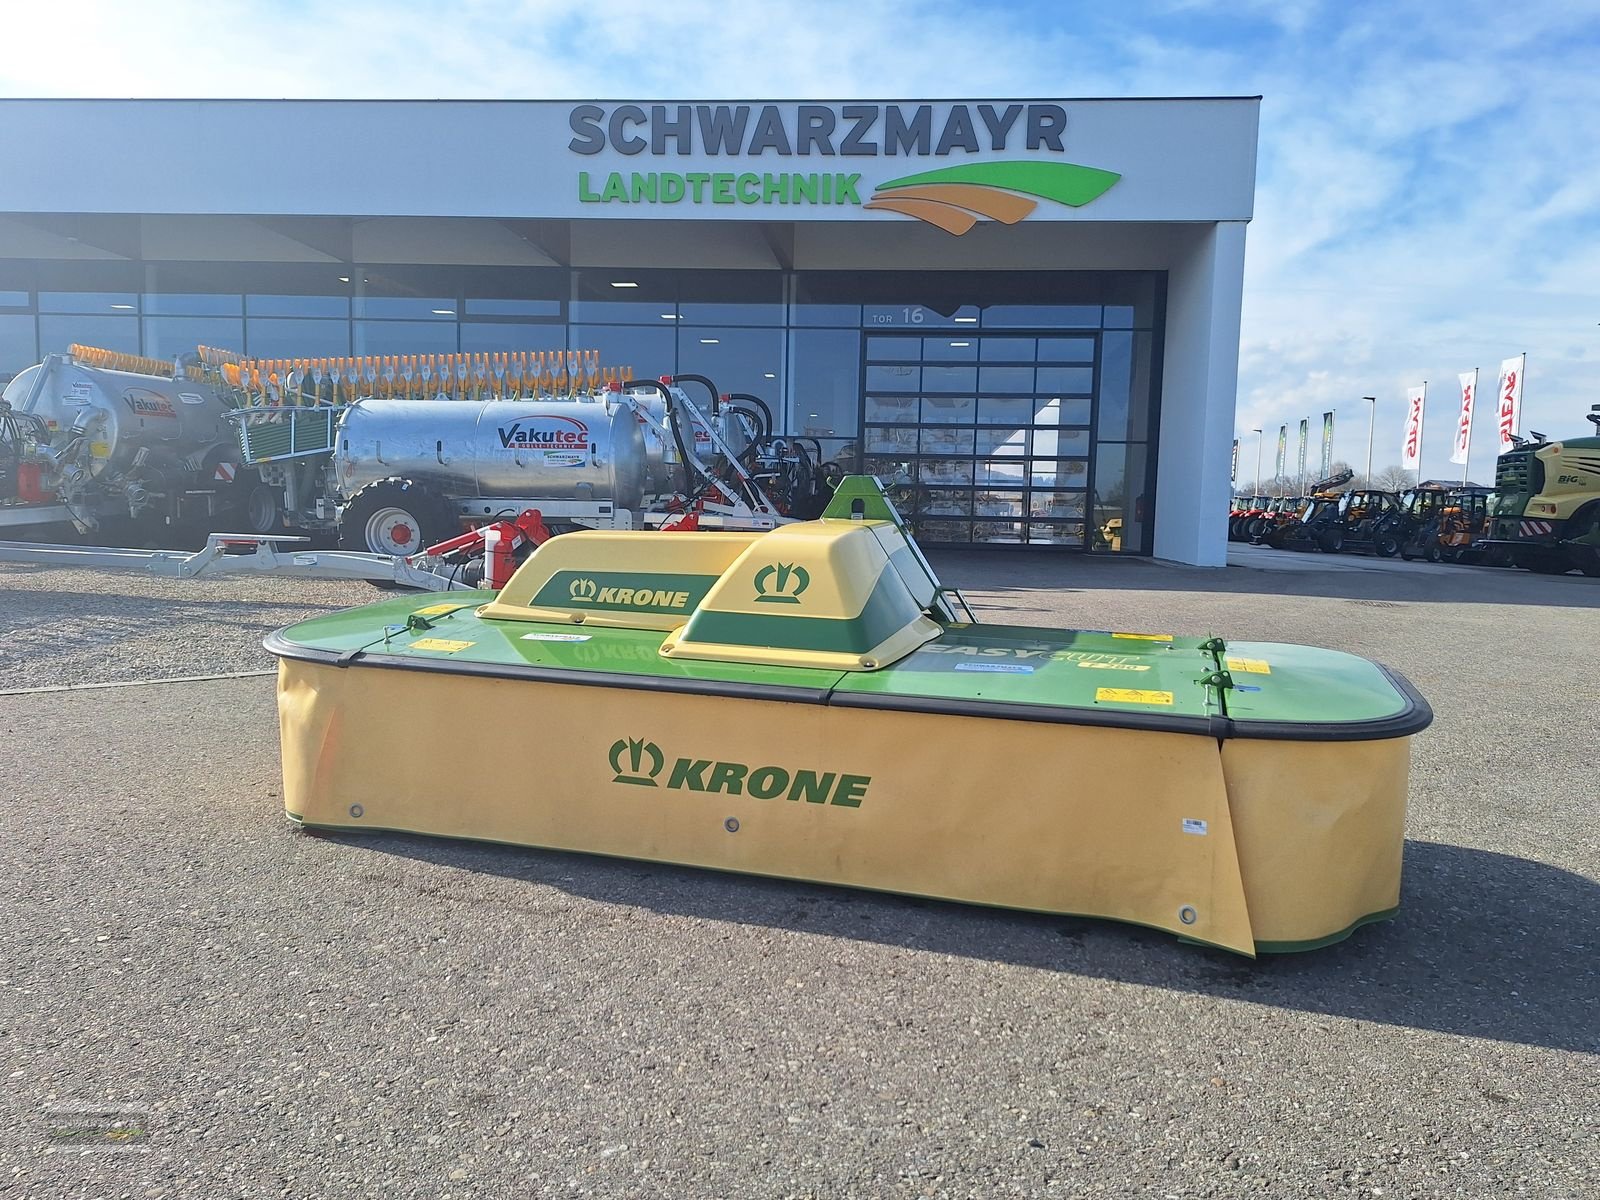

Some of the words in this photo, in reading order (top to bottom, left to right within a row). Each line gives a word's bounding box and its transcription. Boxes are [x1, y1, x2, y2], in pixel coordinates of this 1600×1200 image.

[568, 104, 1068, 156] SCHWARZMAYR
[578, 171, 862, 206] LANDTECHNIK
[872, 315, 893, 323] TOR
[903, 307, 924, 324] 16
[123, 394, 176, 413] Vakutec
[497, 423, 589, 449] Vakutec
[596, 587, 690, 608] KRONE
[919, 643, 1044, 659] EASY
[667, 757, 872, 809] KRONE
